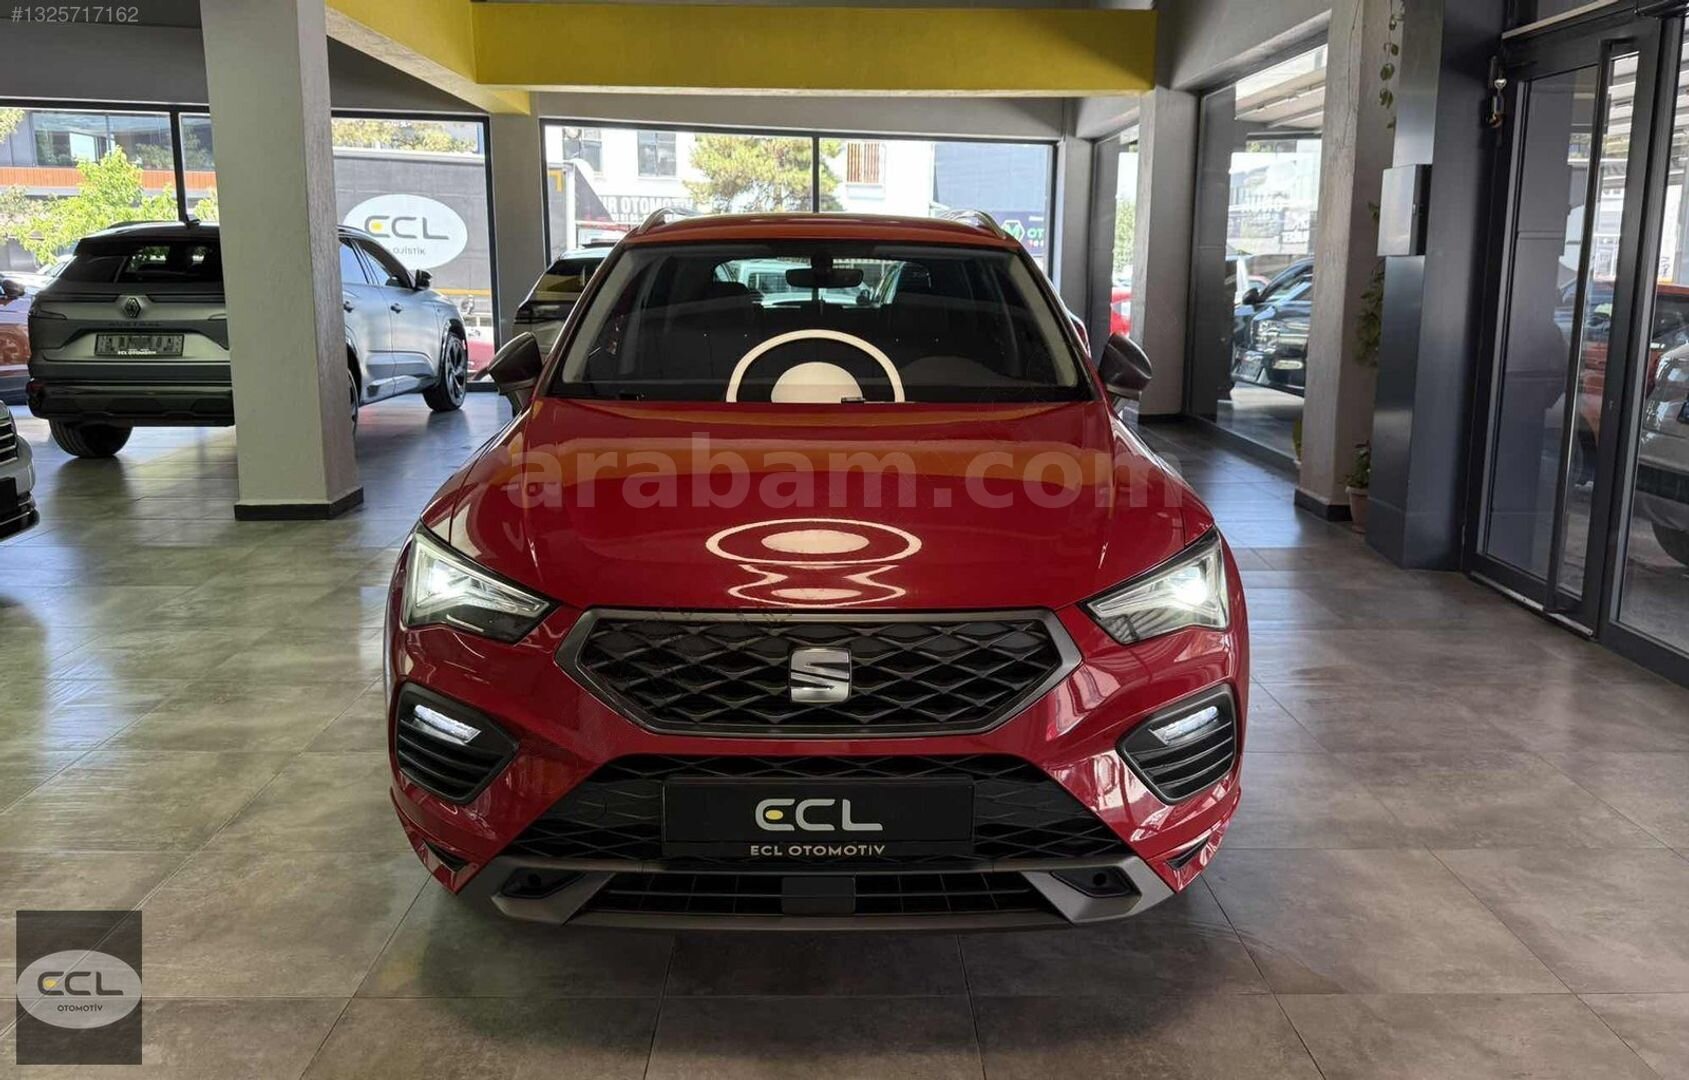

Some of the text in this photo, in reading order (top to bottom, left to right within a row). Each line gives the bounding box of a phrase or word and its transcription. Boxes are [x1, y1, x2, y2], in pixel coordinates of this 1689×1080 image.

[364, 215, 450, 240] ECL
[391, 245, 427, 257] OJİSTİK
[755, 798, 883, 831] ECL
[750, 845, 782, 856] ECL
